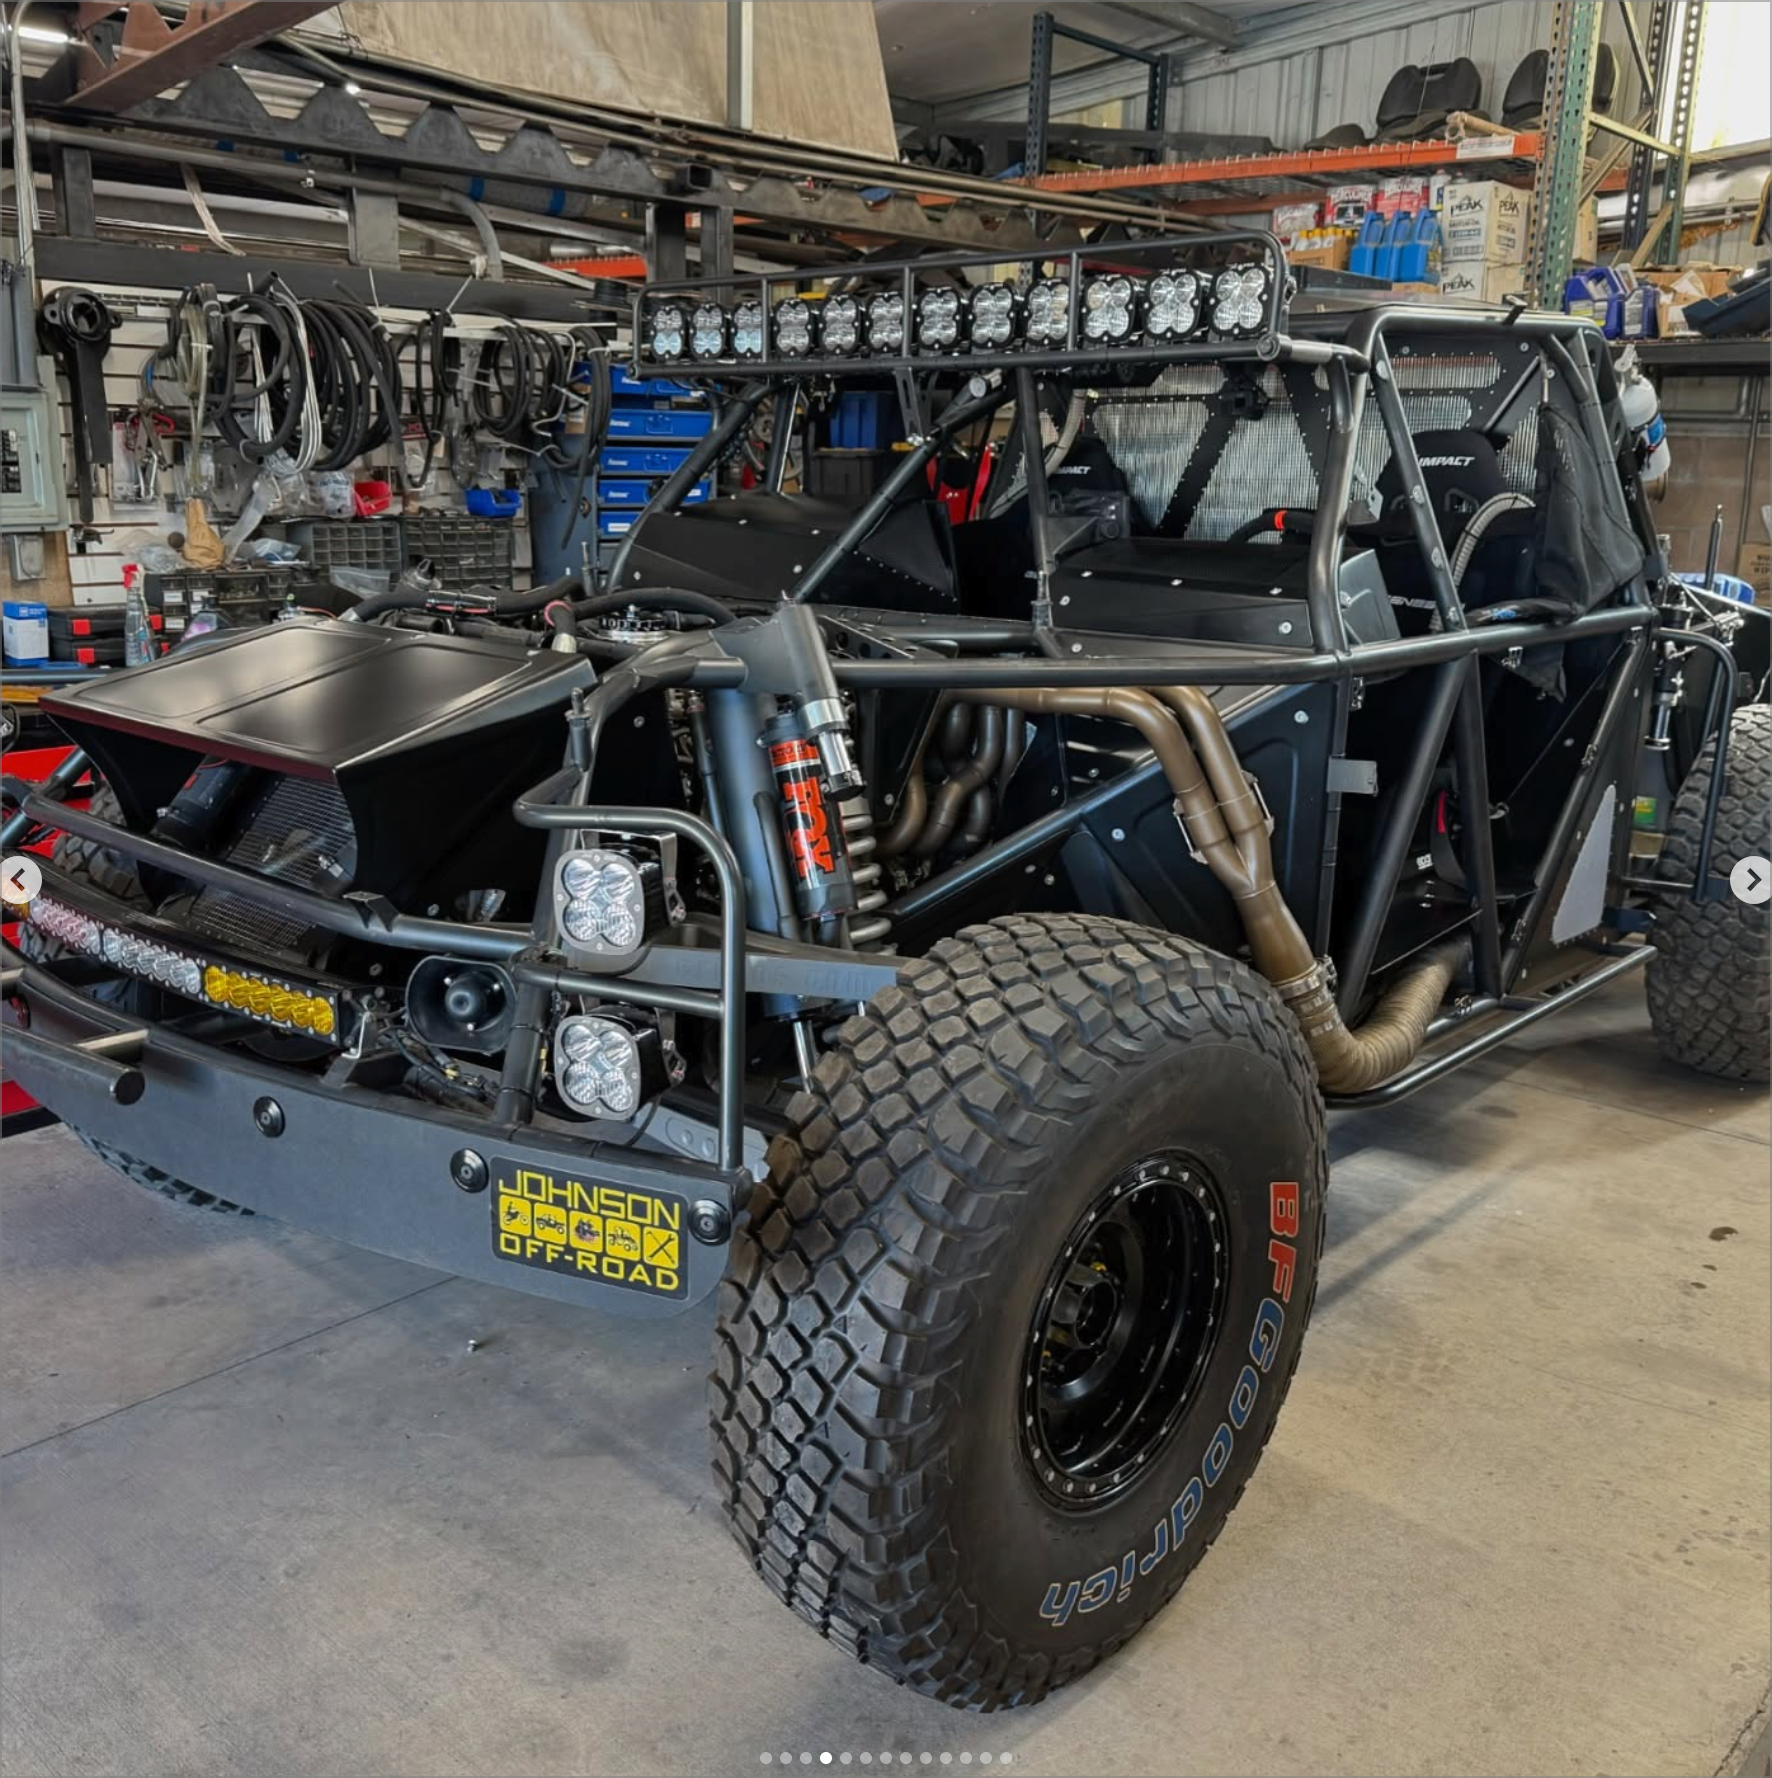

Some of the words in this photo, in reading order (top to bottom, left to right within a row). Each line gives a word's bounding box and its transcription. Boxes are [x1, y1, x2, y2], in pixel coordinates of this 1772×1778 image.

[1450, 199, 1485, 216] PEAK
[1498, 200, 1520, 216] PEAK
[1442, 277, 1476, 294] PEAK
[782, 775, 836, 879] FOX
[498, 1169, 681, 1230] JOHNSON
[499, 1231, 680, 1291] OFF-ROAD
